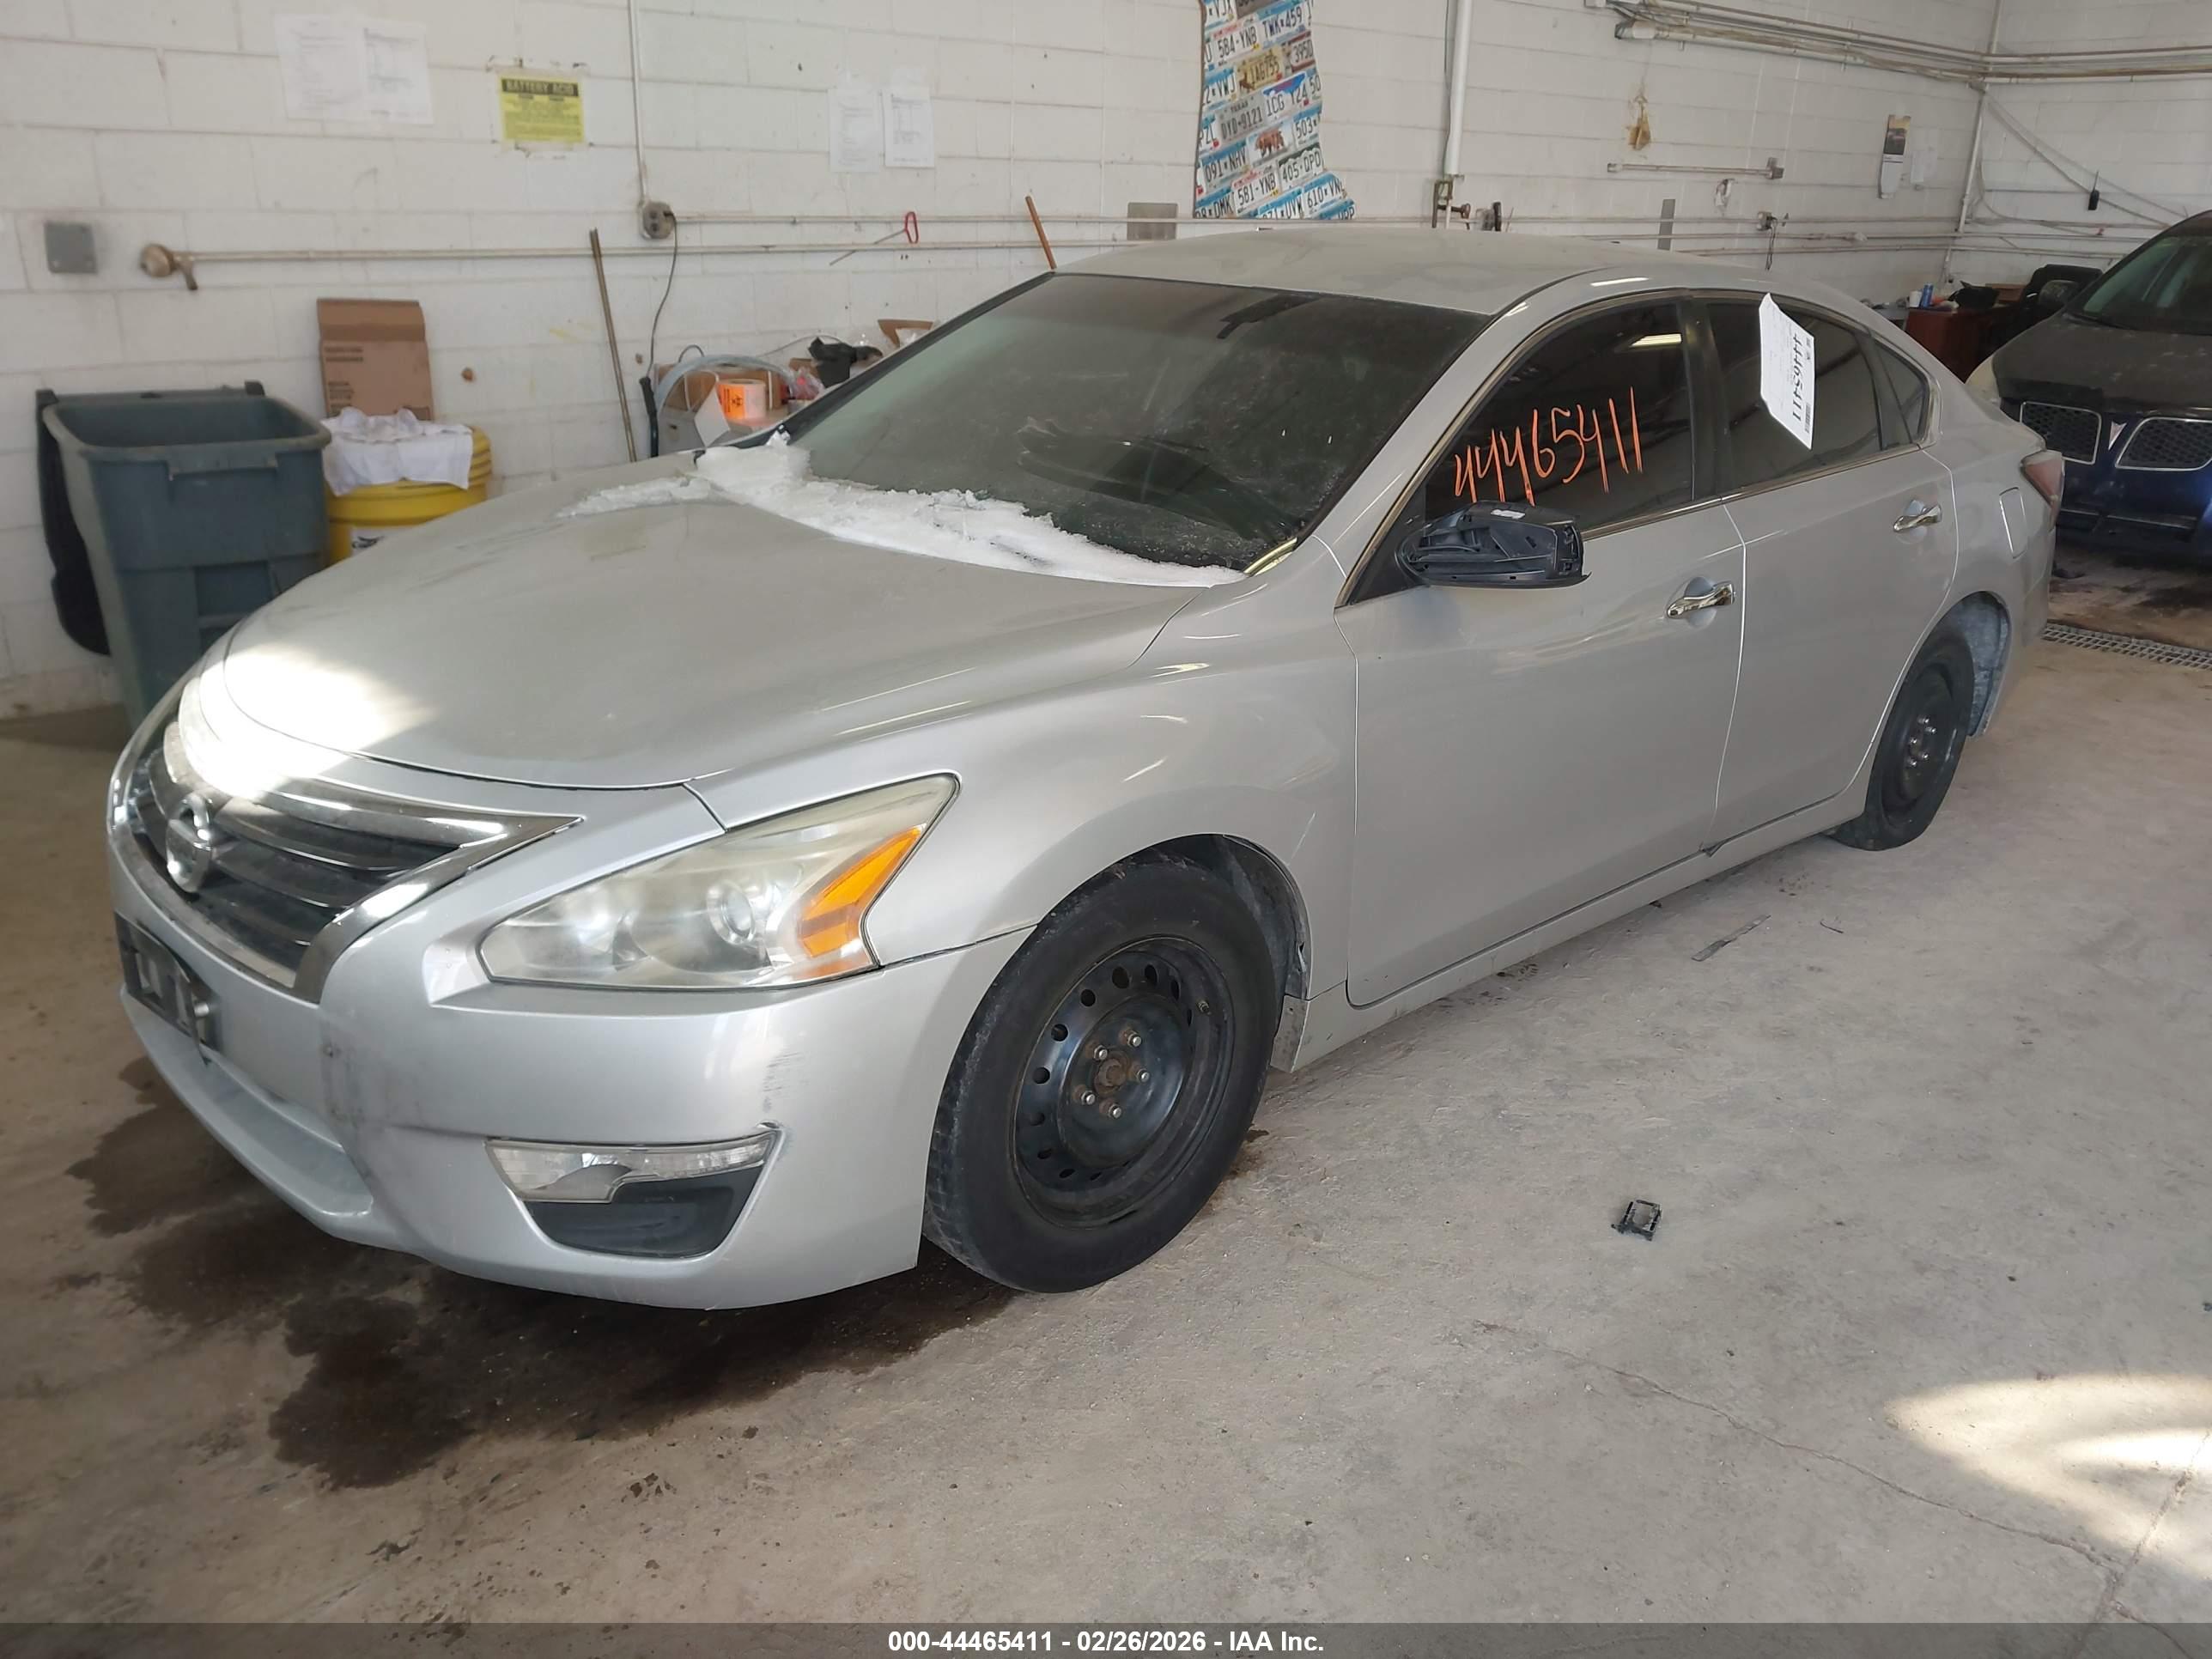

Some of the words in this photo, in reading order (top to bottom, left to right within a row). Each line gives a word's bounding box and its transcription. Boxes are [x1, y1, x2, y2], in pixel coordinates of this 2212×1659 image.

[1218, 26, 1259, 58] 584-YNB
[506, 80, 550, 94] BATTERY
[1237, 173, 1276, 206] 581-YNB
[1454, 386, 1644, 507] 44465411
